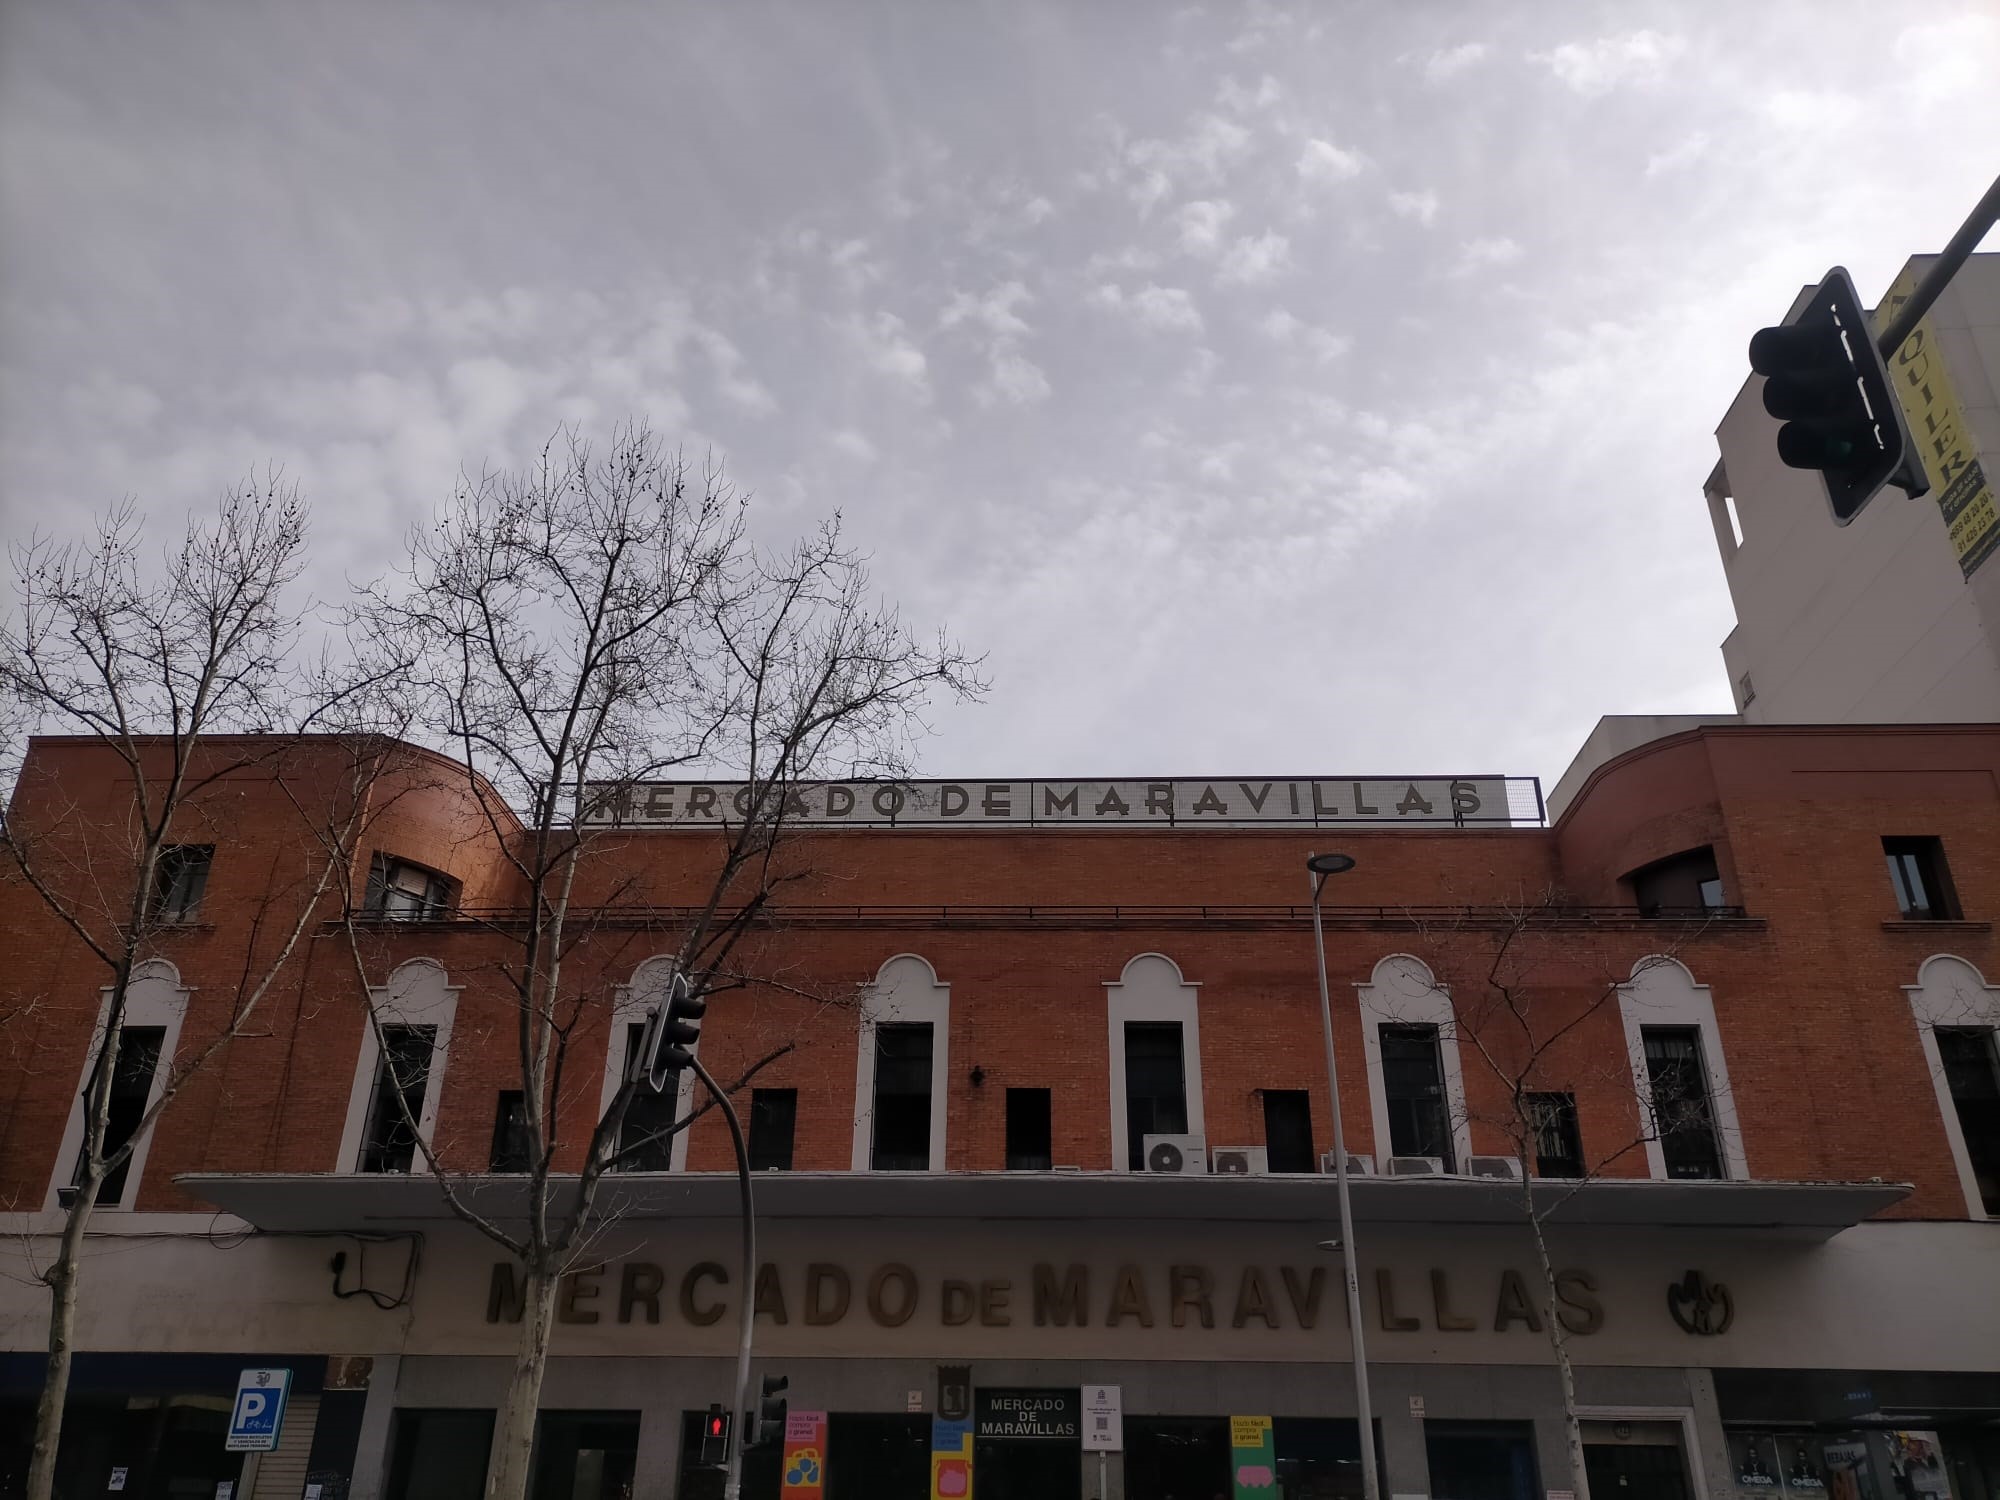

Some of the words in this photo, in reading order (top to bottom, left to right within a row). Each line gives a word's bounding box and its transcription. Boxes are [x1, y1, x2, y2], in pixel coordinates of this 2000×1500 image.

[595, 785, 905, 818] MERCADO
[940, 784, 1012, 817] DE
[1045, 780, 1482, 817] MARAVILLAS
[941, 1278, 1012, 1327] DE
[1032, 1261, 1606, 1335] MARAVLLAS
[236, 1393, 266, 1429] P
[991, 1399, 1065, 1410] MERCADO
[1019, 1411, 1038, 1422] DE
[981, 1422, 1075, 1435] MARAVILLAS
